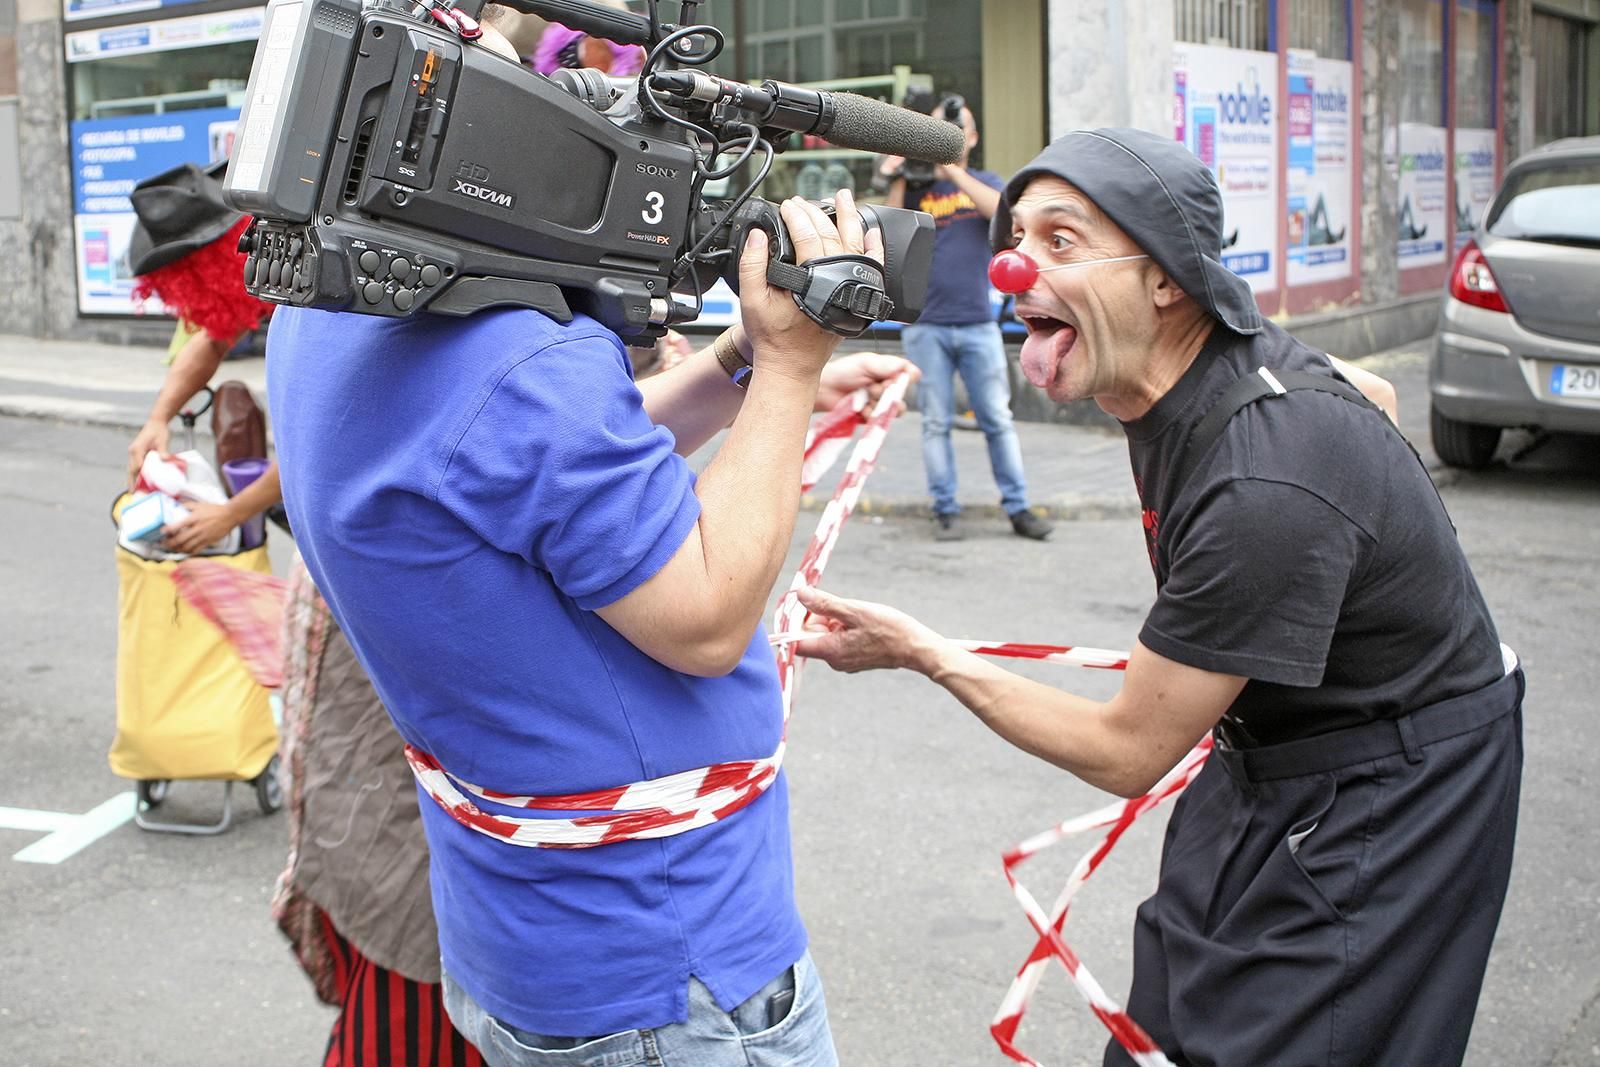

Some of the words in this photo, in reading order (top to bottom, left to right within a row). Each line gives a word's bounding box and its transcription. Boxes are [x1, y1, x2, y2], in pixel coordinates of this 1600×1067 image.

[456, 159, 490, 182] HD
[635, 162, 680, 179] SONY
[453, 179, 513, 207] XDCAM
[641, 191, 665, 225] 3
[852, 265, 880, 285] Canon
[1569, 369, 1600, 390] 20
